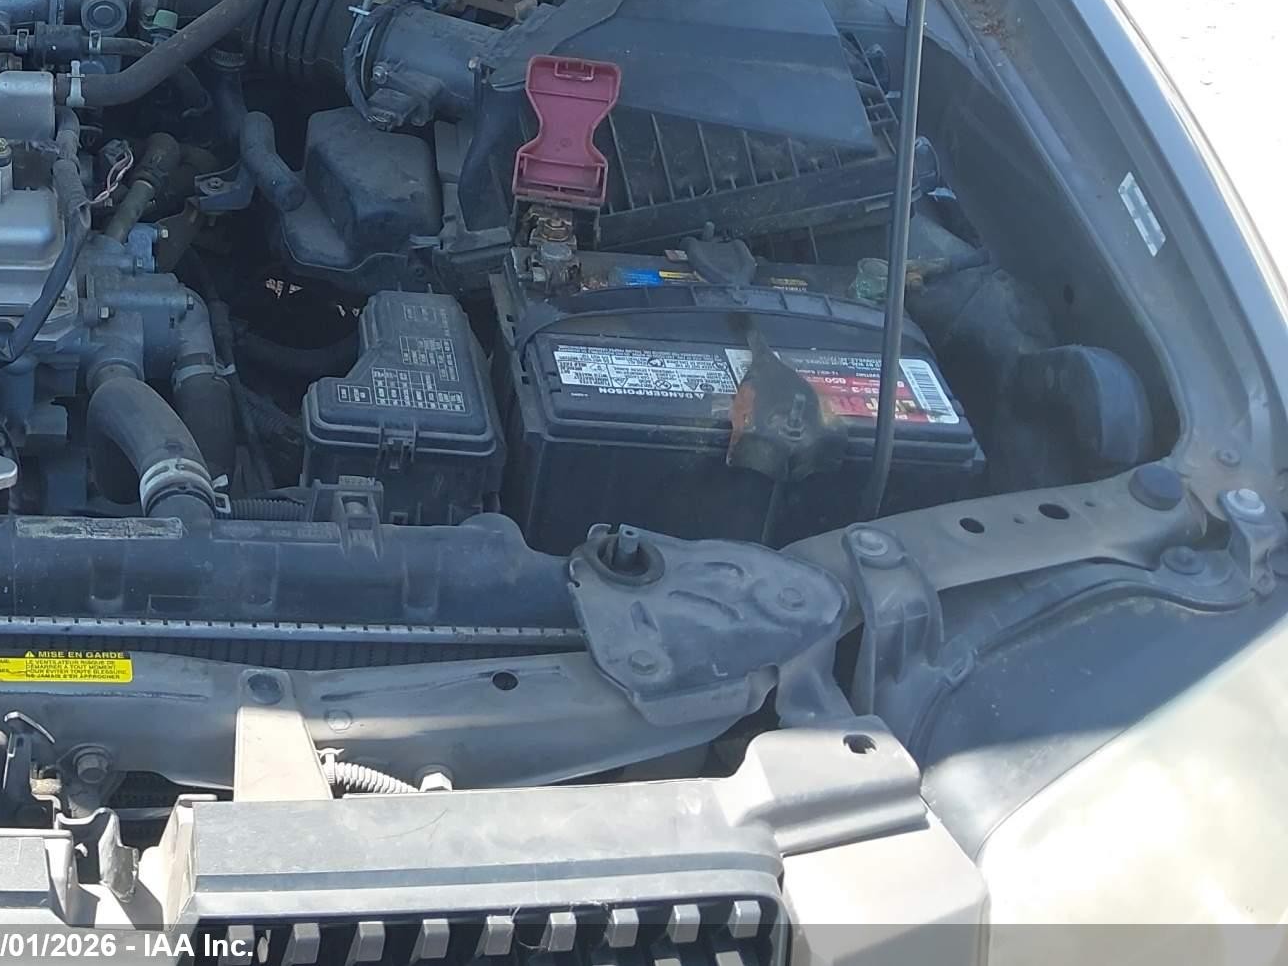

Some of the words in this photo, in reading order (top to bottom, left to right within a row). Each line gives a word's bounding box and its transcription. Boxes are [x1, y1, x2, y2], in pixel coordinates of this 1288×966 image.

[598, 387, 694, 400] DANGER/POISON
[67, 651, 83, 659] EN
[85, 651, 124, 659] GARDE
